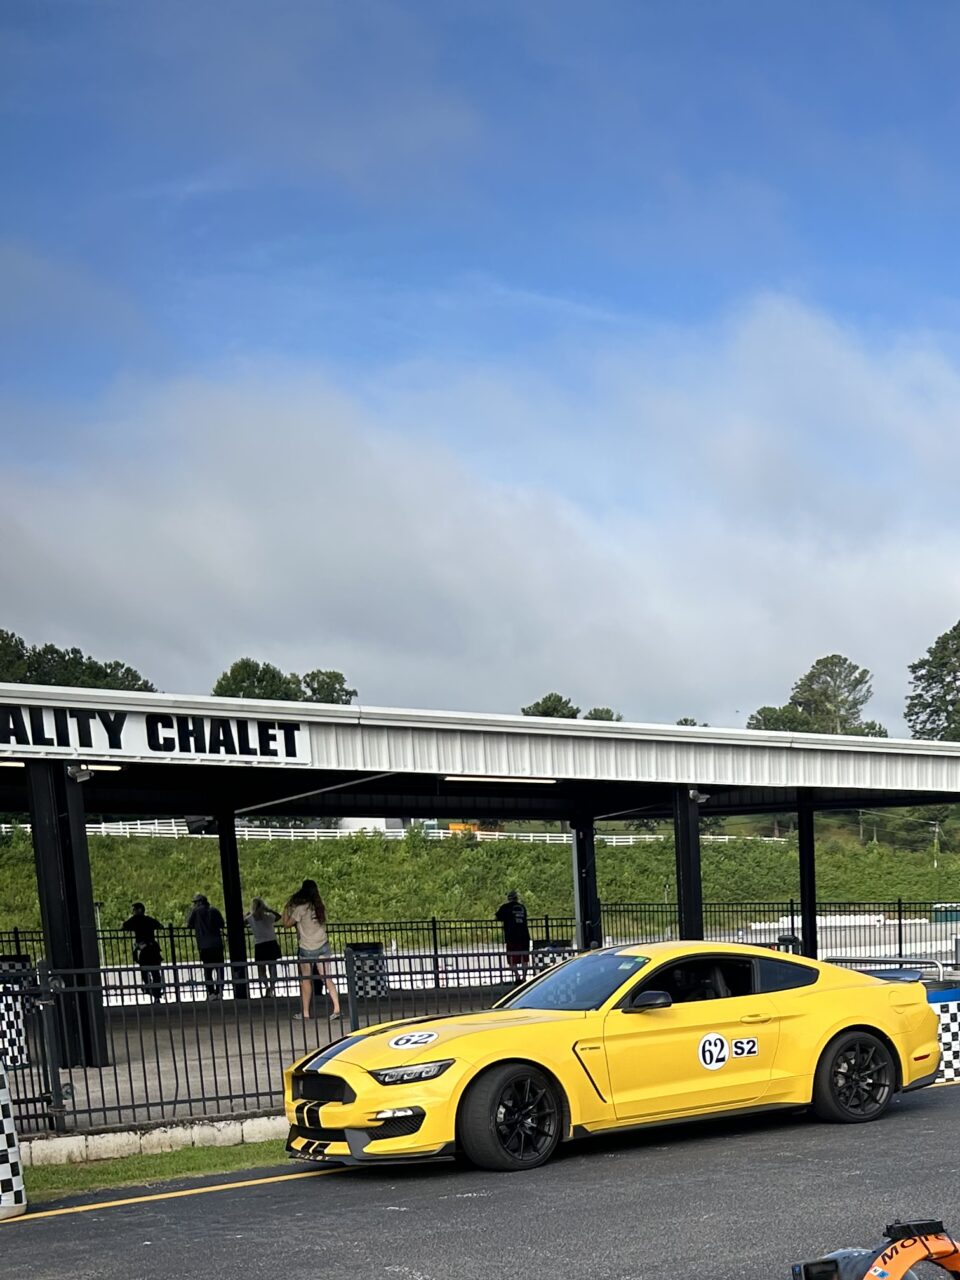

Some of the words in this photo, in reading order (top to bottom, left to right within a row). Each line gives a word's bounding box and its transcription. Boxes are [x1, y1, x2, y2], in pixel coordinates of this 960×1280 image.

[0, 705, 127, 750] ALITY
[145, 713, 301, 758] CHALET
[394, 1032, 435, 1047] 62
[701, 1037, 727, 1066] 62
[733, 1039, 758, 1056] S2
